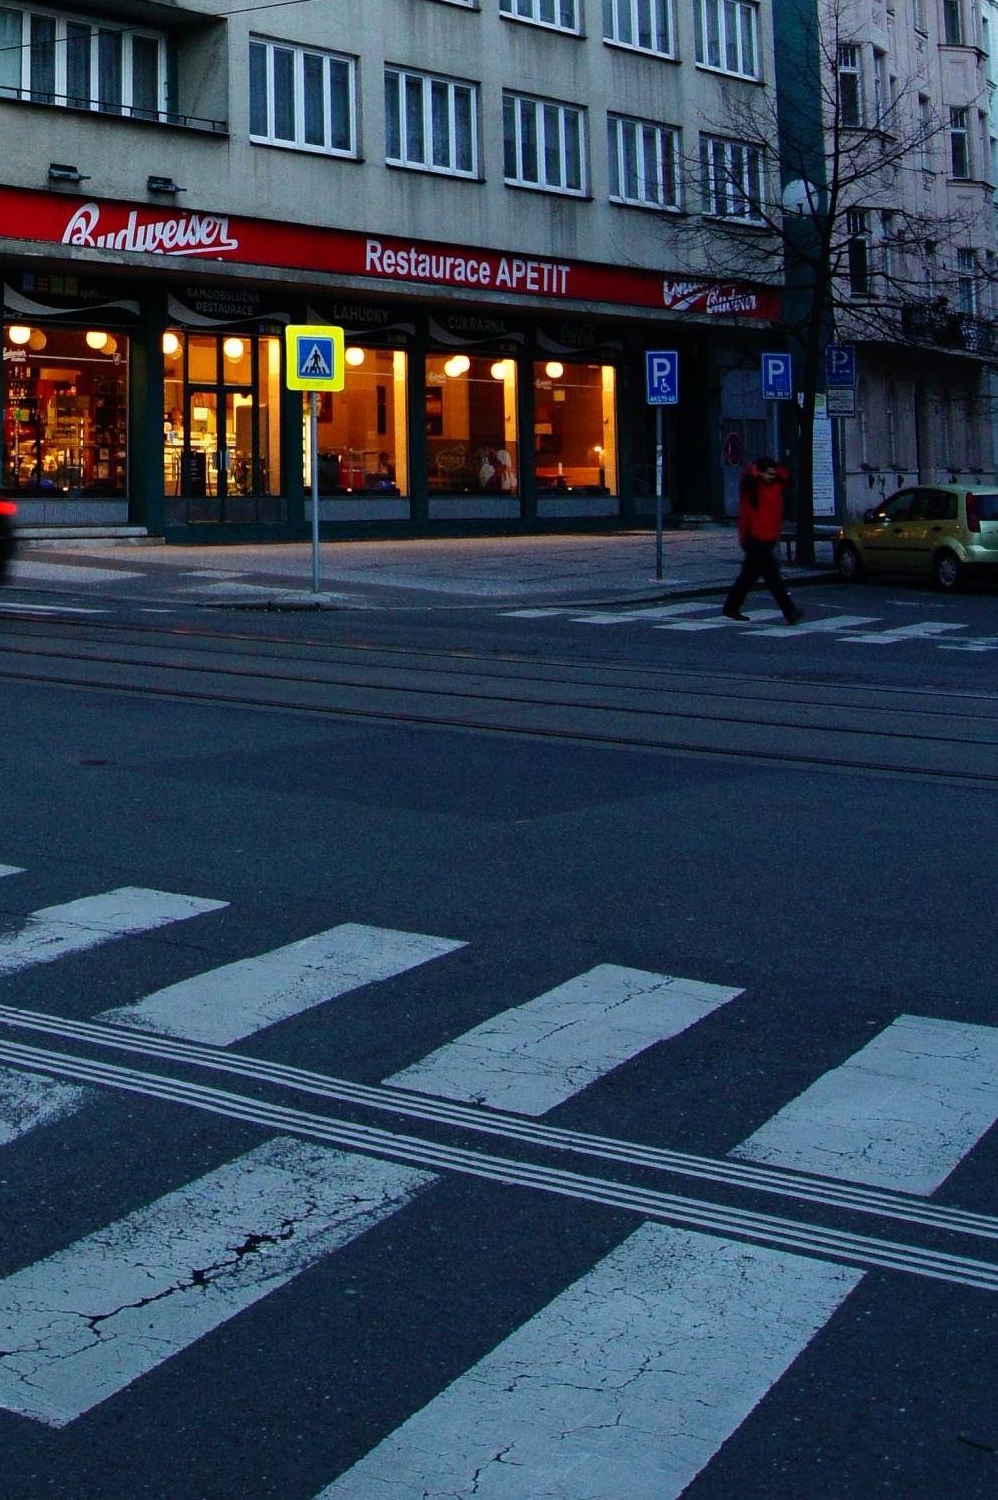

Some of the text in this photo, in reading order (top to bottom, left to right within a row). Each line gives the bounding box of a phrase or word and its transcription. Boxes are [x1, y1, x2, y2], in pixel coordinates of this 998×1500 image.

[62, 201, 238, 256] Budweiser
[365, 239, 571, 294] Restaurace APETIT
[196, 301, 254, 316] RESTAURACE
[653, 358, 671, 388] P
[768, 359, 785, 386] P
